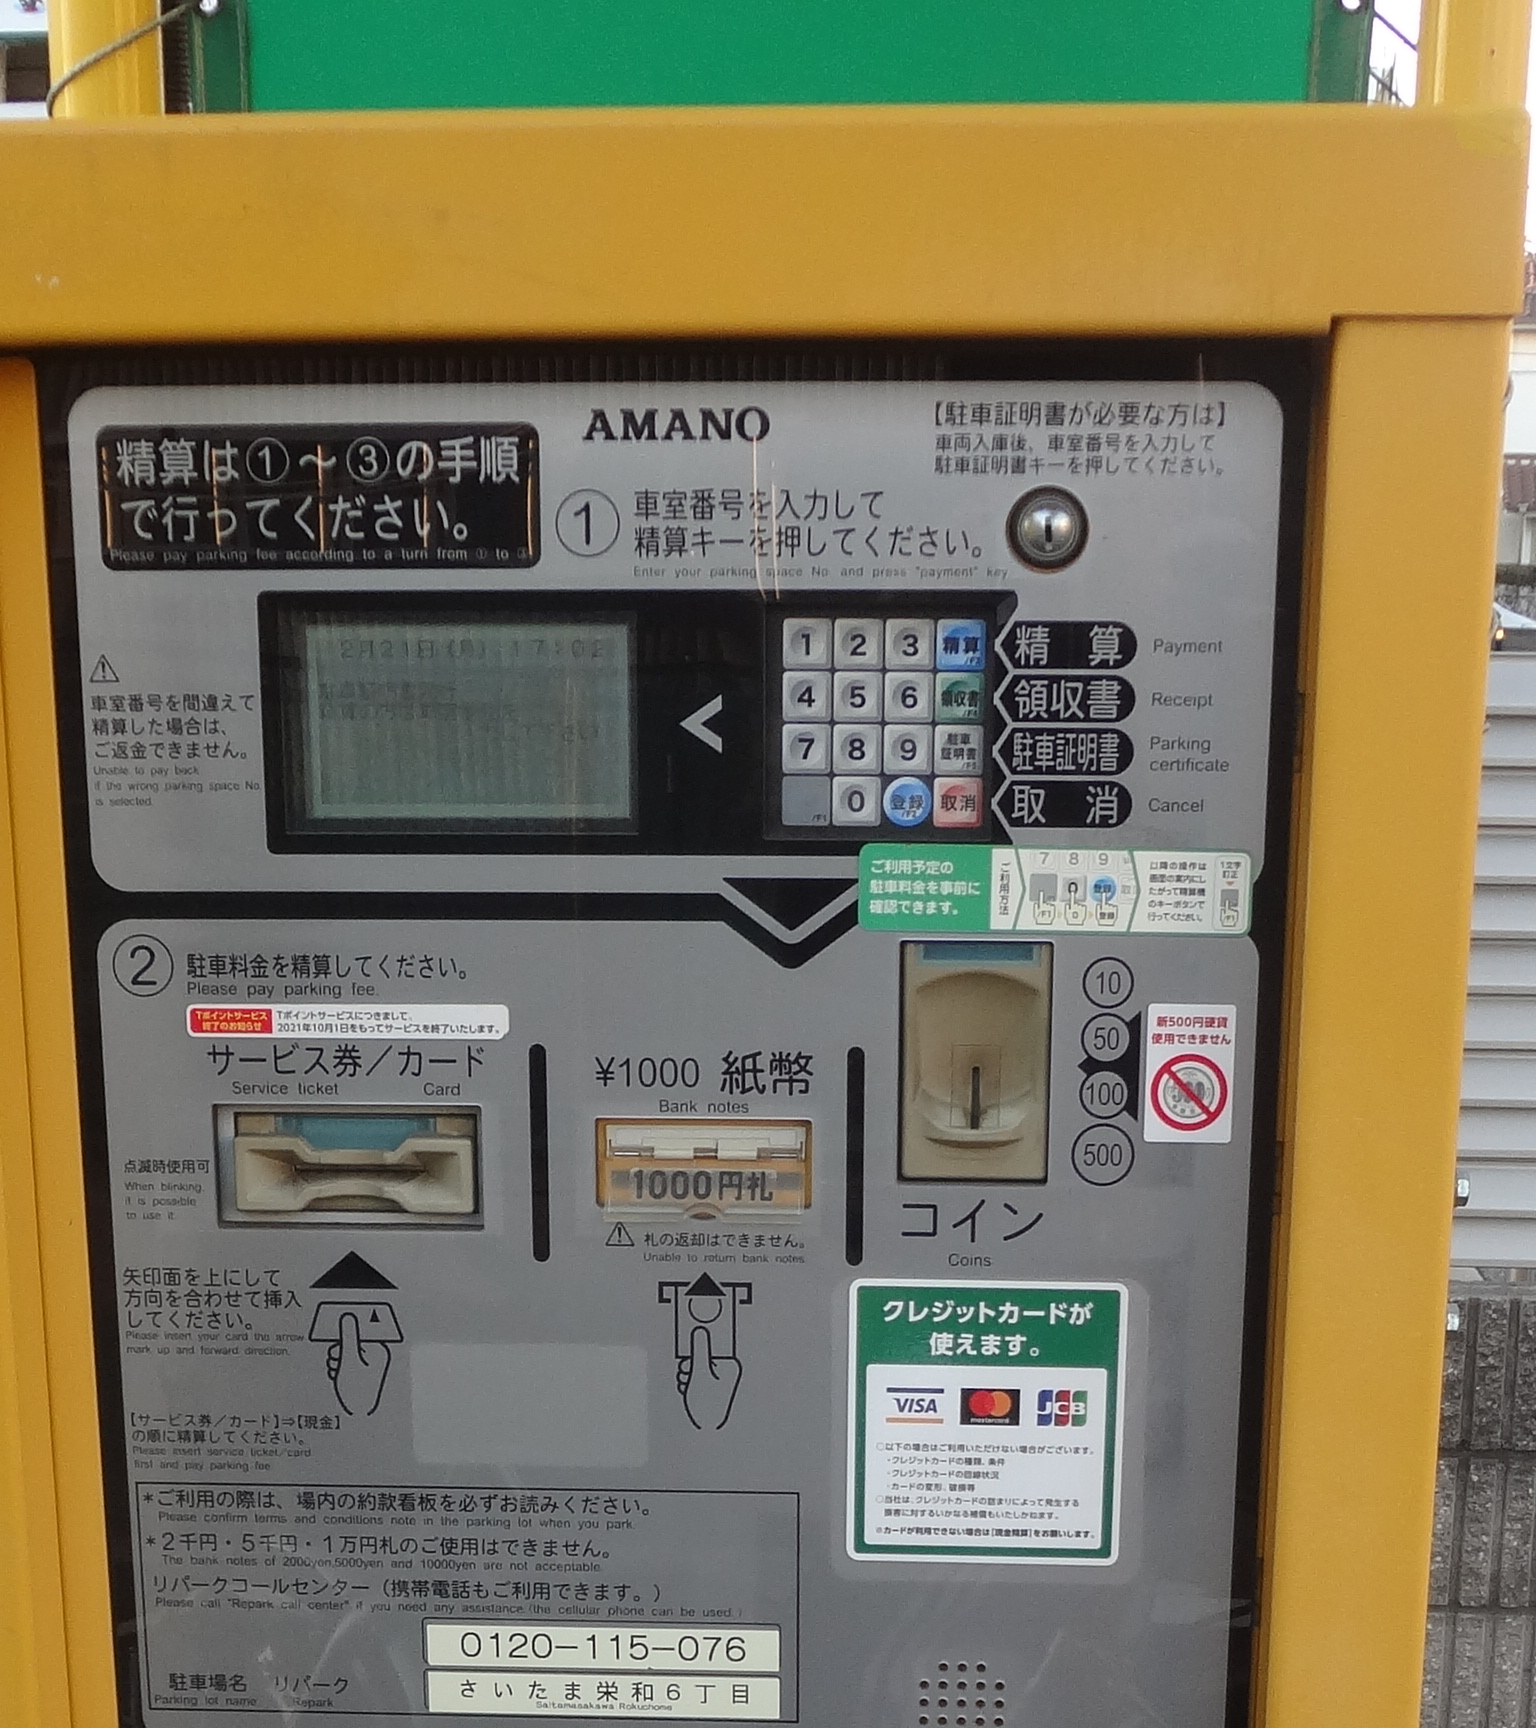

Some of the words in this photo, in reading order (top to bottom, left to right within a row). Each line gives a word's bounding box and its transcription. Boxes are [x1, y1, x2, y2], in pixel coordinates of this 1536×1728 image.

[582, 406, 770, 442] AMANO
[935, 401, 1226, 427] 【駐車証明書が必要な方は】
[935, 455, 1225, 476] 駐車証明書キーを押してください。
[634, 488, 884, 521] 車室番号を入力して
[122, 495, 469, 543] で行ってください。
[634, 525, 982, 559] 精算キーを押してください。
[801, 633, 811, 656] 1
[850, 633, 867, 657] 2
[901, 634, 919, 657] 3
[942, 636, 980, 656] 精算
[1153, 639, 1223, 657] Payment
[91, 693, 255, 714] 車室番号を間違えて
[797, 686, 815, 708] 4
[850, 686, 866, 708] 5
[901, 687, 918, 709] 6
[1014, 679, 1122, 719] 領収書
[1151, 692, 1214, 710] Receipt
[92, 716, 229, 738] 精算した場合は、
[94, 740, 250, 761] ご返金できません。
[798, 738, 815, 760] 7
[849, 738, 866, 761] 8
[900, 738, 917, 761] 9
[1013, 732, 1120, 772] 駐車証明書
[1150, 736, 1211, 754] Parking
[1149, 757, 1230, 772] certificate
[848, 790, 865, 812] 0
[941, 795, 977, 813] 取消
[1148, 798, 1204, 813] Cancel
[870, 859, 954, 875] ご利用予定の
[870, 880, 981, 896] 駐車料金を事前に
[997, 861, 1011, 916] ご利用方法
[870, 900, 960, 916] 確認できます。
[186, 953, 467, 981] 駐車料金を精算してください。
[186, 982, 238, 996] Please
[246, 986, 275, 999] pay
[284, 983, 342, 999] parking
[1096, 971, 1121, 995] 10
[1156, 1016, 1228, 1029] 新500円硬貨
[1093, 1027, 1119, 1051] 50
[1151, 1033, 1231, 1046] 使用できません
[207, 1043, 485, 1078] サービス券／カード
[595, 1056, 700, 1088] ¥1000
[720, 1050, 813, 1096] 紙幣
[232, 1081, 289, 1095] Service
[298, 1081, 339, 1095] ticket
[423, 1082, 460, 1096] Card
[1085, 1082, 1124, 1106] 100
[659, 1100, 698, 1113] Bank
[707, 1102, 749, 1113] notes
[1083, 1143, 1123, 1167] 500
[124, 1159, 210, 1175] 点滅時使用可
[632, 1169, 773, 1202] 1000円札
[902, 1199, 1043, 1243] コイン
[644, 1231, 805, 1249] 札の返却はできません。
[948, 1253, 992, 1268] Coins
[122, 1266, 280, 1288] 矢印面を上にして
[125, 1289, 302, 1310] 方向を合わせて挿入
[127, 1311, 253, 1331] してください。
[882, 1300, 1094, 1326] クレジットカードが
[929, 1331, 1040, 1358] 使えます。
[893, 1397, 938, 1414] VISA
[132, 1430, 306, 1446] の順に精算してください。
[460, 1631, 747, 1663] 0120-115-076
[168, 1673, 248, 1692] 駐車場名
[273, 1675, 349, 1695] リパーク
